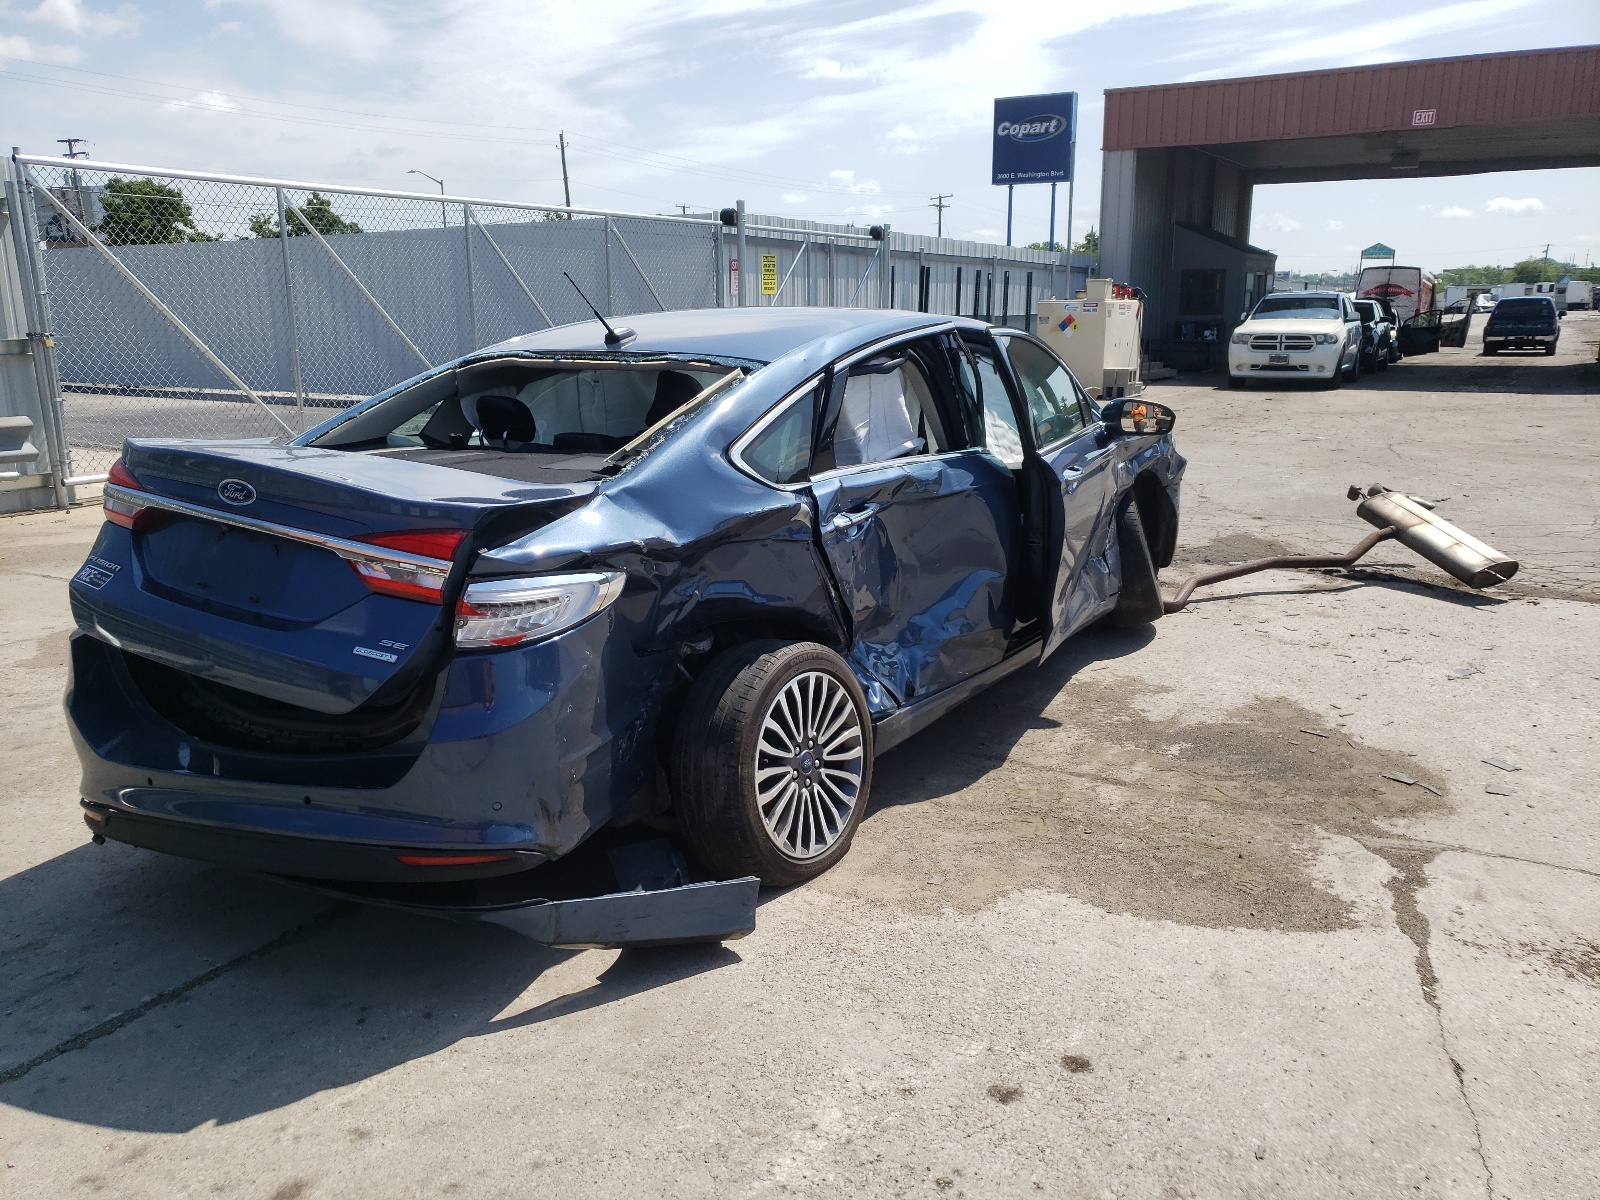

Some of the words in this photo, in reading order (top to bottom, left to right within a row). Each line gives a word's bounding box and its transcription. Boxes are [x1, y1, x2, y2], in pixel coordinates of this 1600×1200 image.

[1415, 111, 1434, 123] EXIT
[997, 118, 1059, 138] Copart
[1017, 171, 1050, 179] Washington
[224, 483, 247, 500] Ford
[379, 639, 410, 651] SE
[790, 652, 818, 665] ENERGY
